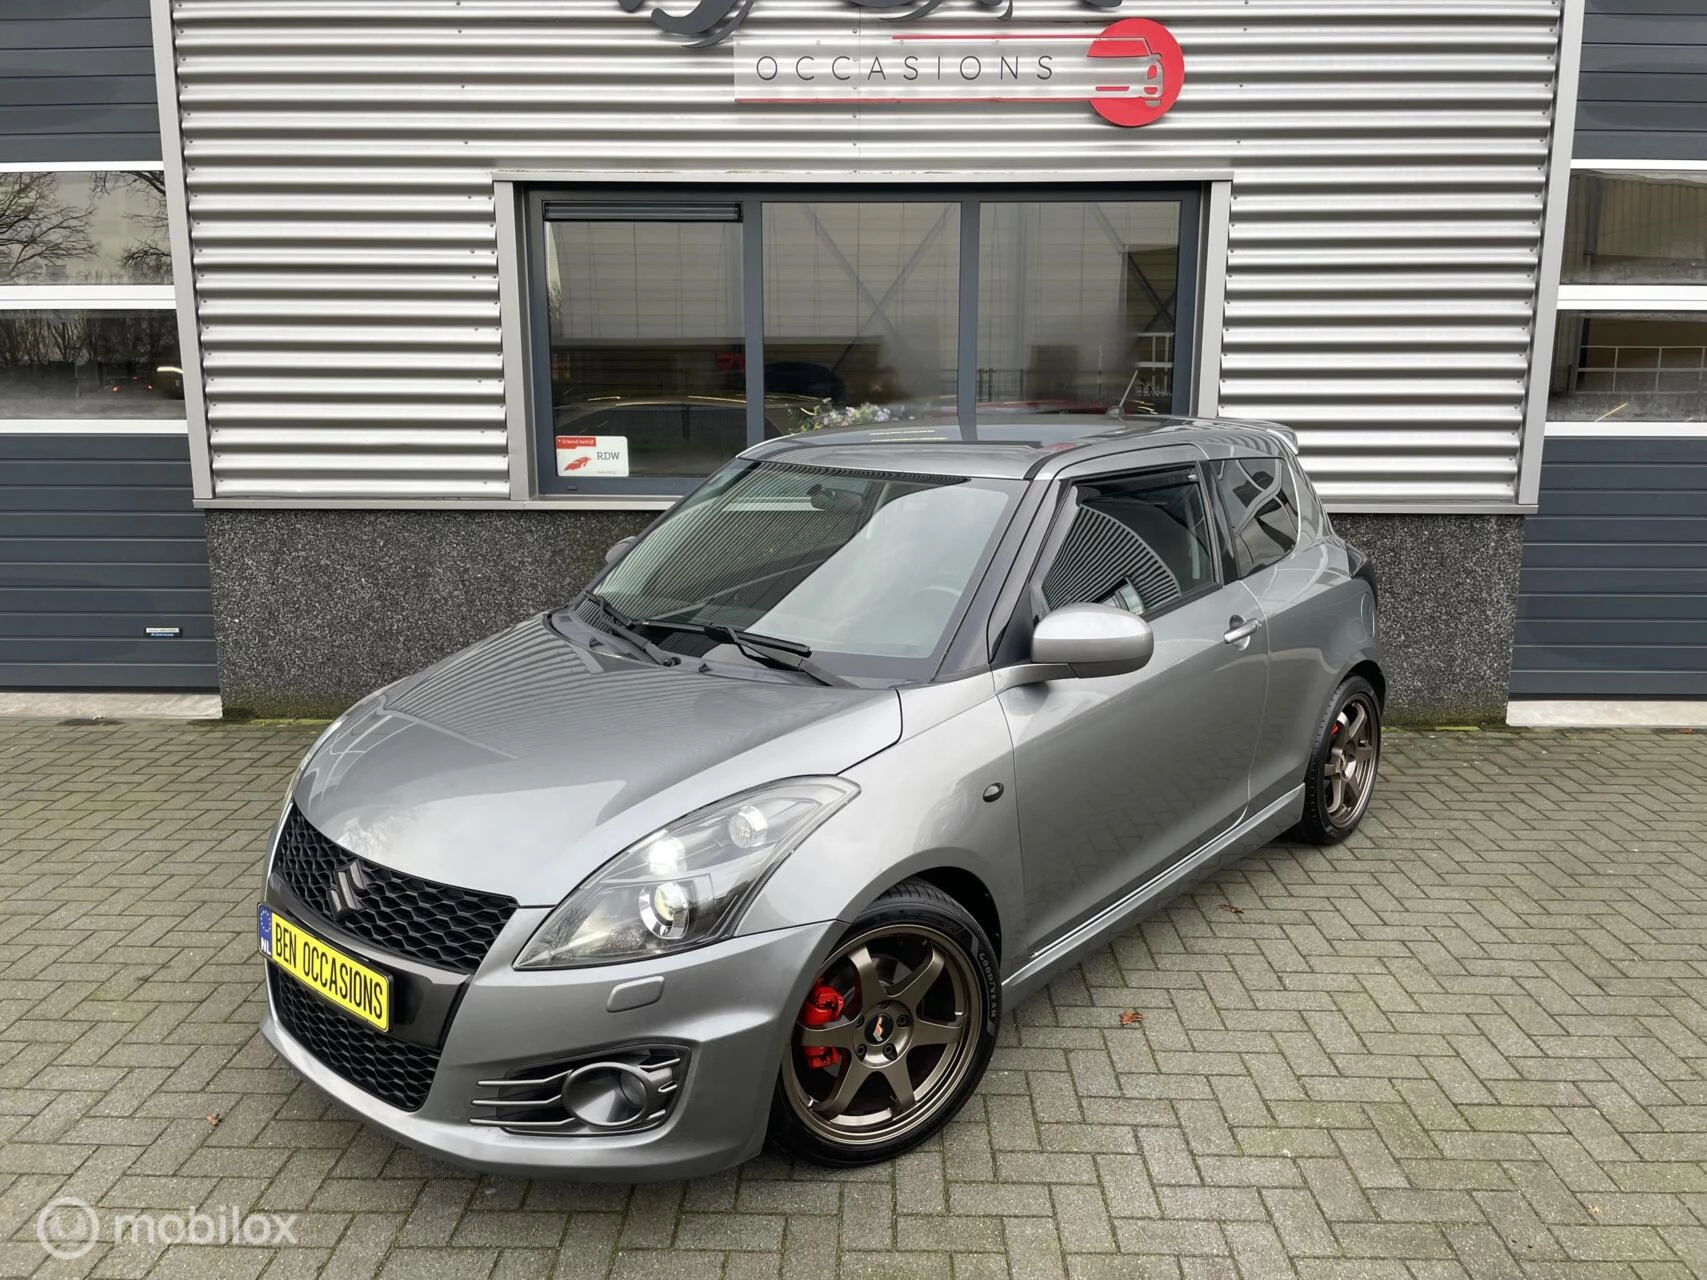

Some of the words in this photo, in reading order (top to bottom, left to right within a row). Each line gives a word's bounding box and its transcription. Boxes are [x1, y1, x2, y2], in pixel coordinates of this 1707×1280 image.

[755, 55, 1054, 81] OCCASIONS
[596, 451, 620, 461] RDW
[260, 937, 271, 956] NL
[275, 922, 297, 968] BEN
[302, 941, 383, 1020] OCCASIONS
